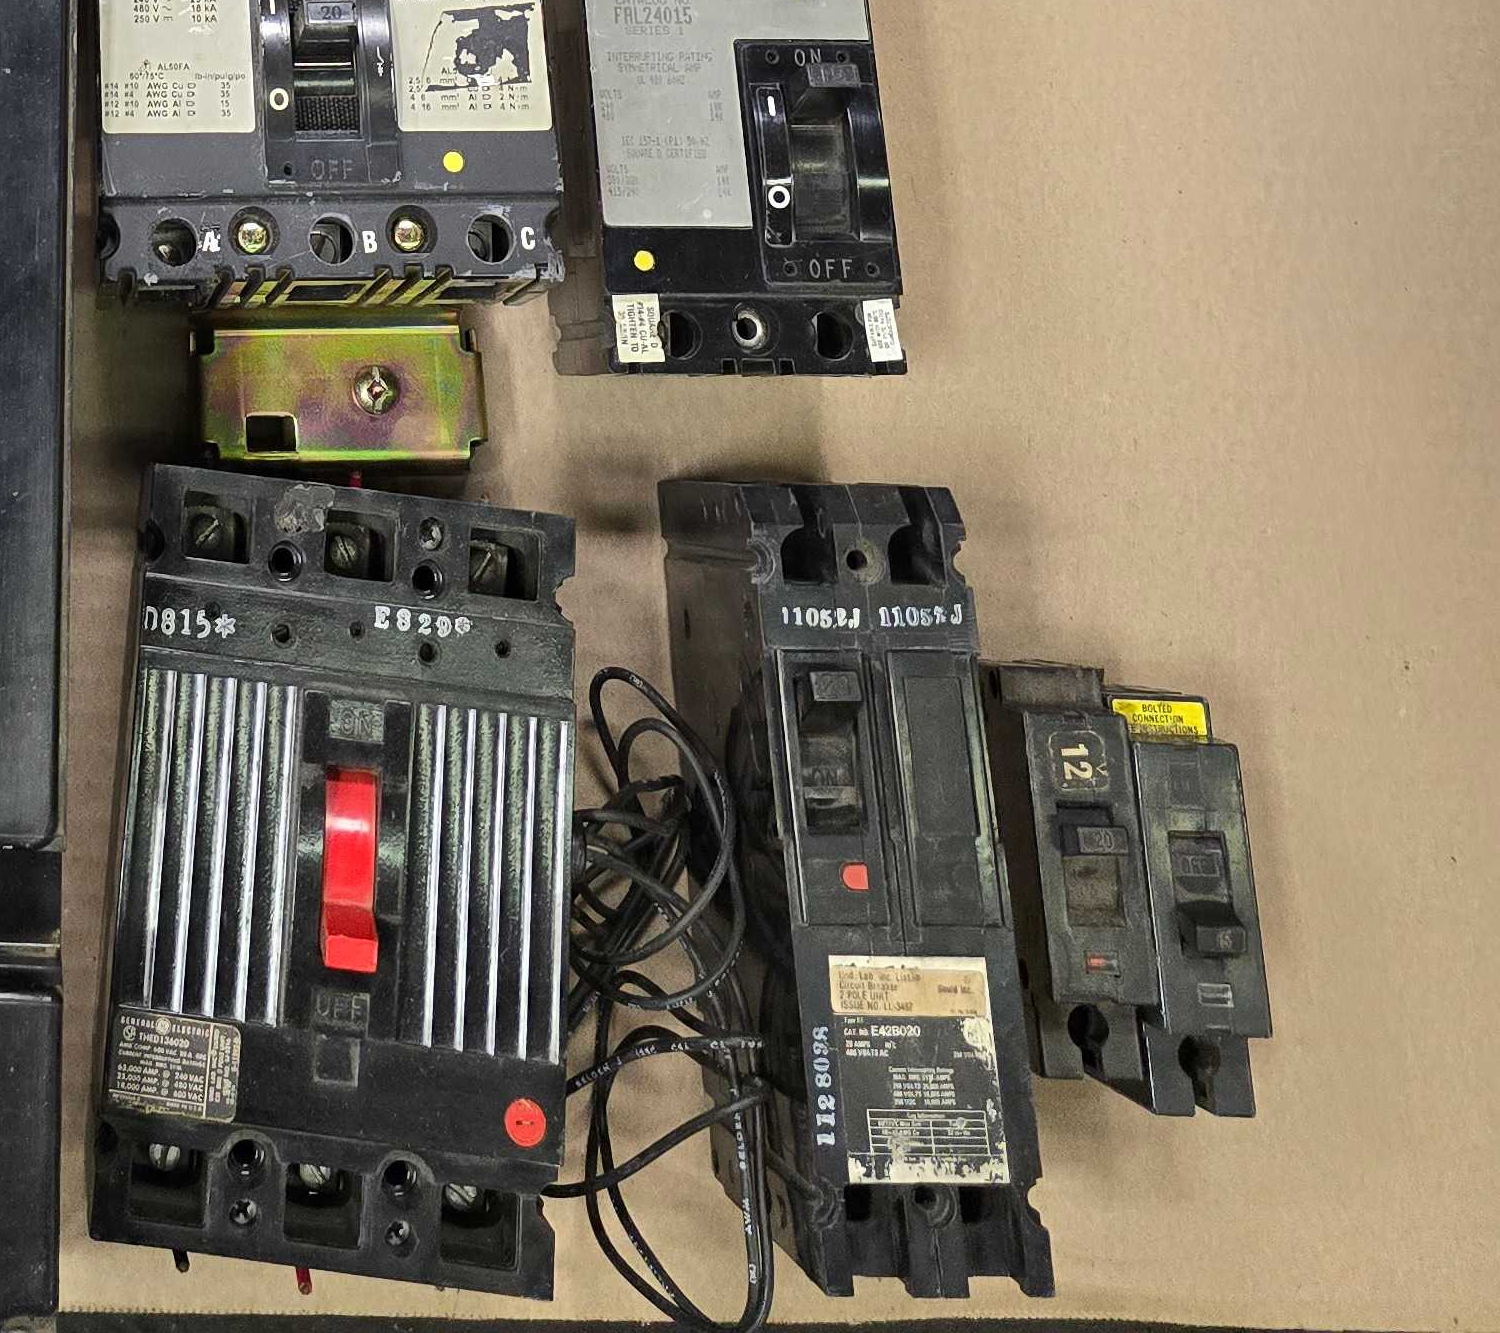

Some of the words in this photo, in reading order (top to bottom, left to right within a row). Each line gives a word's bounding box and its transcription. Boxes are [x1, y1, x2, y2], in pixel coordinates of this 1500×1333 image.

[133, 4, 150, 12] 480
[205, 4, 217, 12] kA
[320, 5, 342, 20] 20
[614, 7, 693, 25] FAL24015
[625, 26, 671, 35] SERIES
[607, 51, 675, 62] INTERRUPTING
[679, 51, 713, 62] RATING
[794, 49, 822, 67] ON
[310, 159, 353, 180] OFF
[202, 233, 220, 253] A
[361, 229, 378, 254] B
[520, 226, 536, 249] C
[809, 259, 853, 279] OFF
[627, 304, 637, 338] TIGHTEN
[631, 343, 639, 352] TO
[1142, 704, 1173, 713] BOLTED
[1132, 714, 1184, 724] CONNECTION
[1060, 743, 1093, 780] 12
[847, 991, 867, 1000] POLE
[841, 1001, 864, 1010] ISSUE
[120, 1015, 154, 1029] GENERAL
[172, 1025, 210, 1038] ELECTRIC
[871, 1025, 920, 1037] E42B020
[174, 1072, 188, 1081] 240
[189, 1075, 204, 1084] VAC
[188, 1082, 204, 1092] VAC
[188, 1092, 204, 1102] VAC
